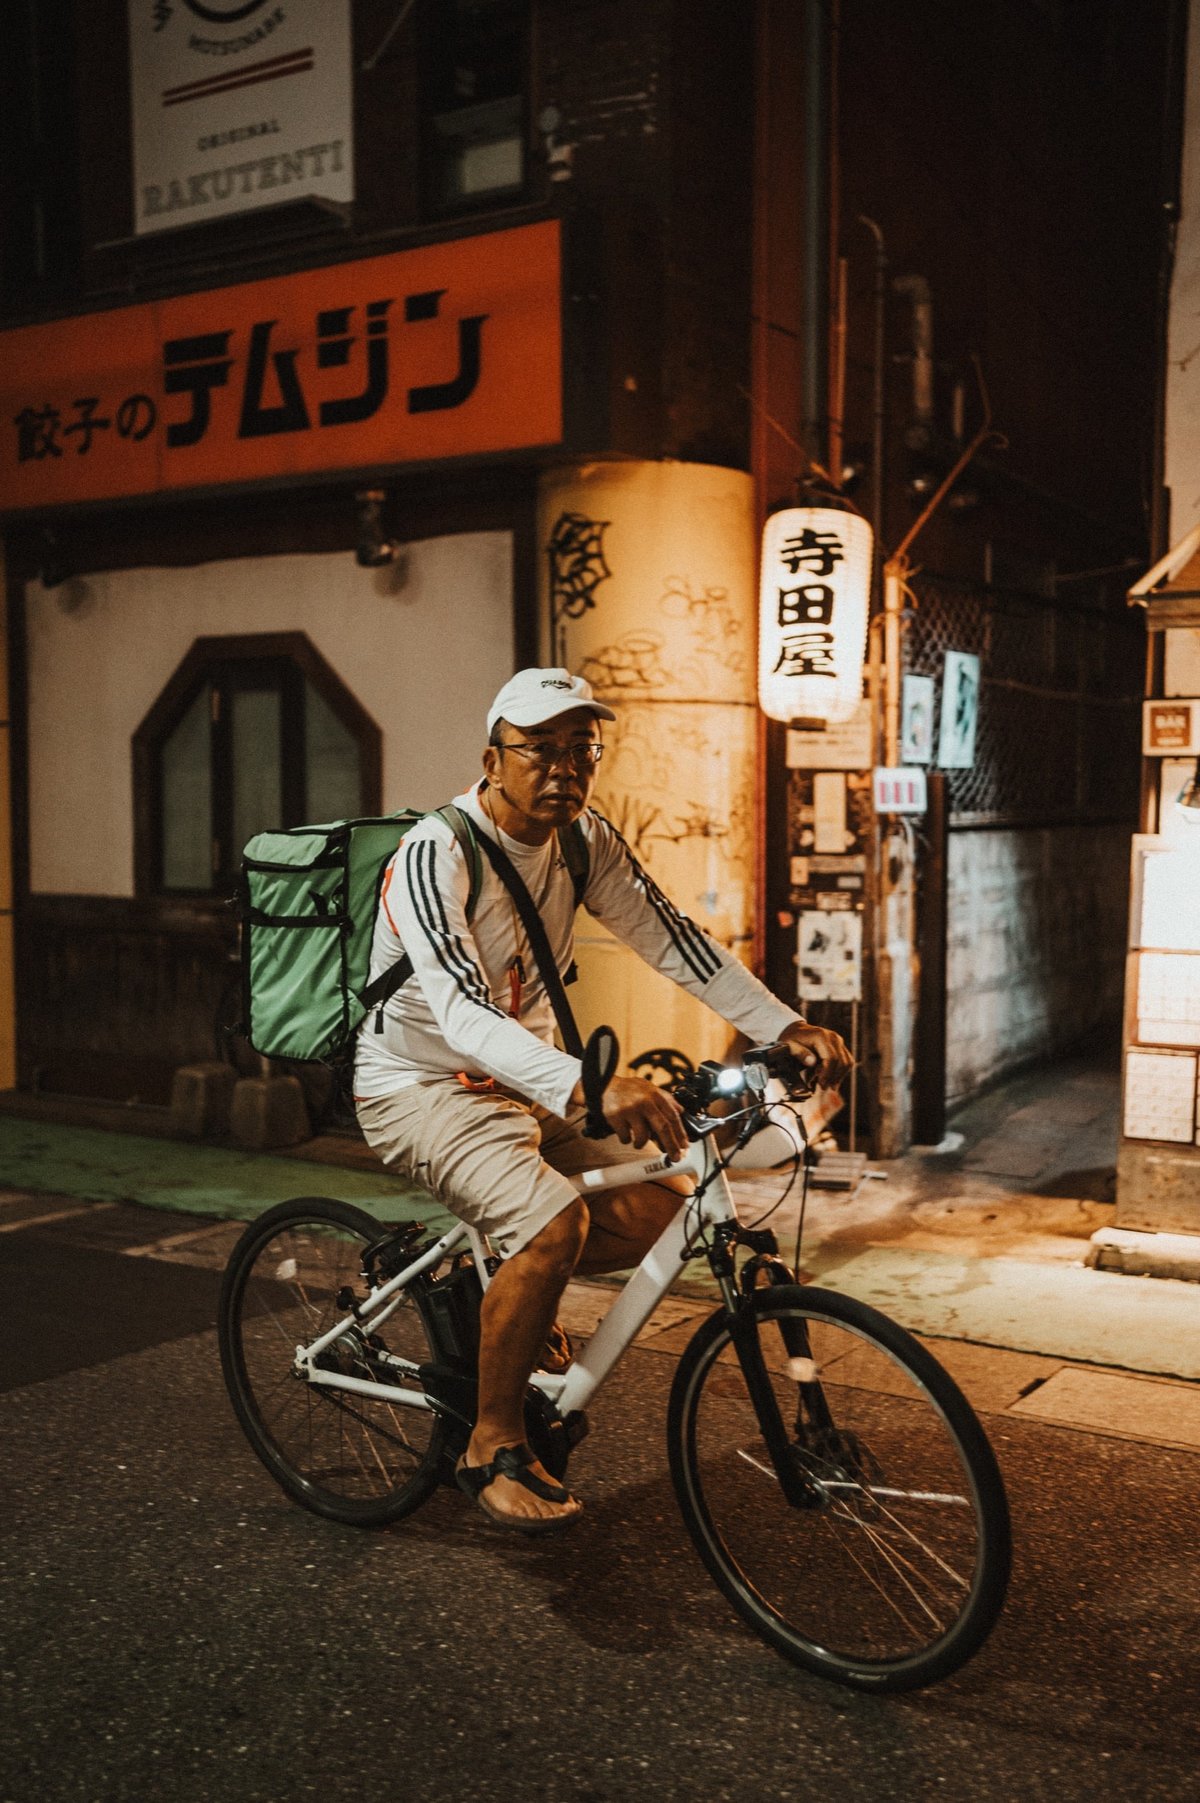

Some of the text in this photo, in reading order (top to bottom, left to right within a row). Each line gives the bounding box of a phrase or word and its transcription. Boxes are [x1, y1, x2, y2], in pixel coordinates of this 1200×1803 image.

[143, 140, 343, 216] RAKUTENTI
[15, 289, 490, 460] 餃子のテムジン
[773, 528, 844, 678] 寺田屋
